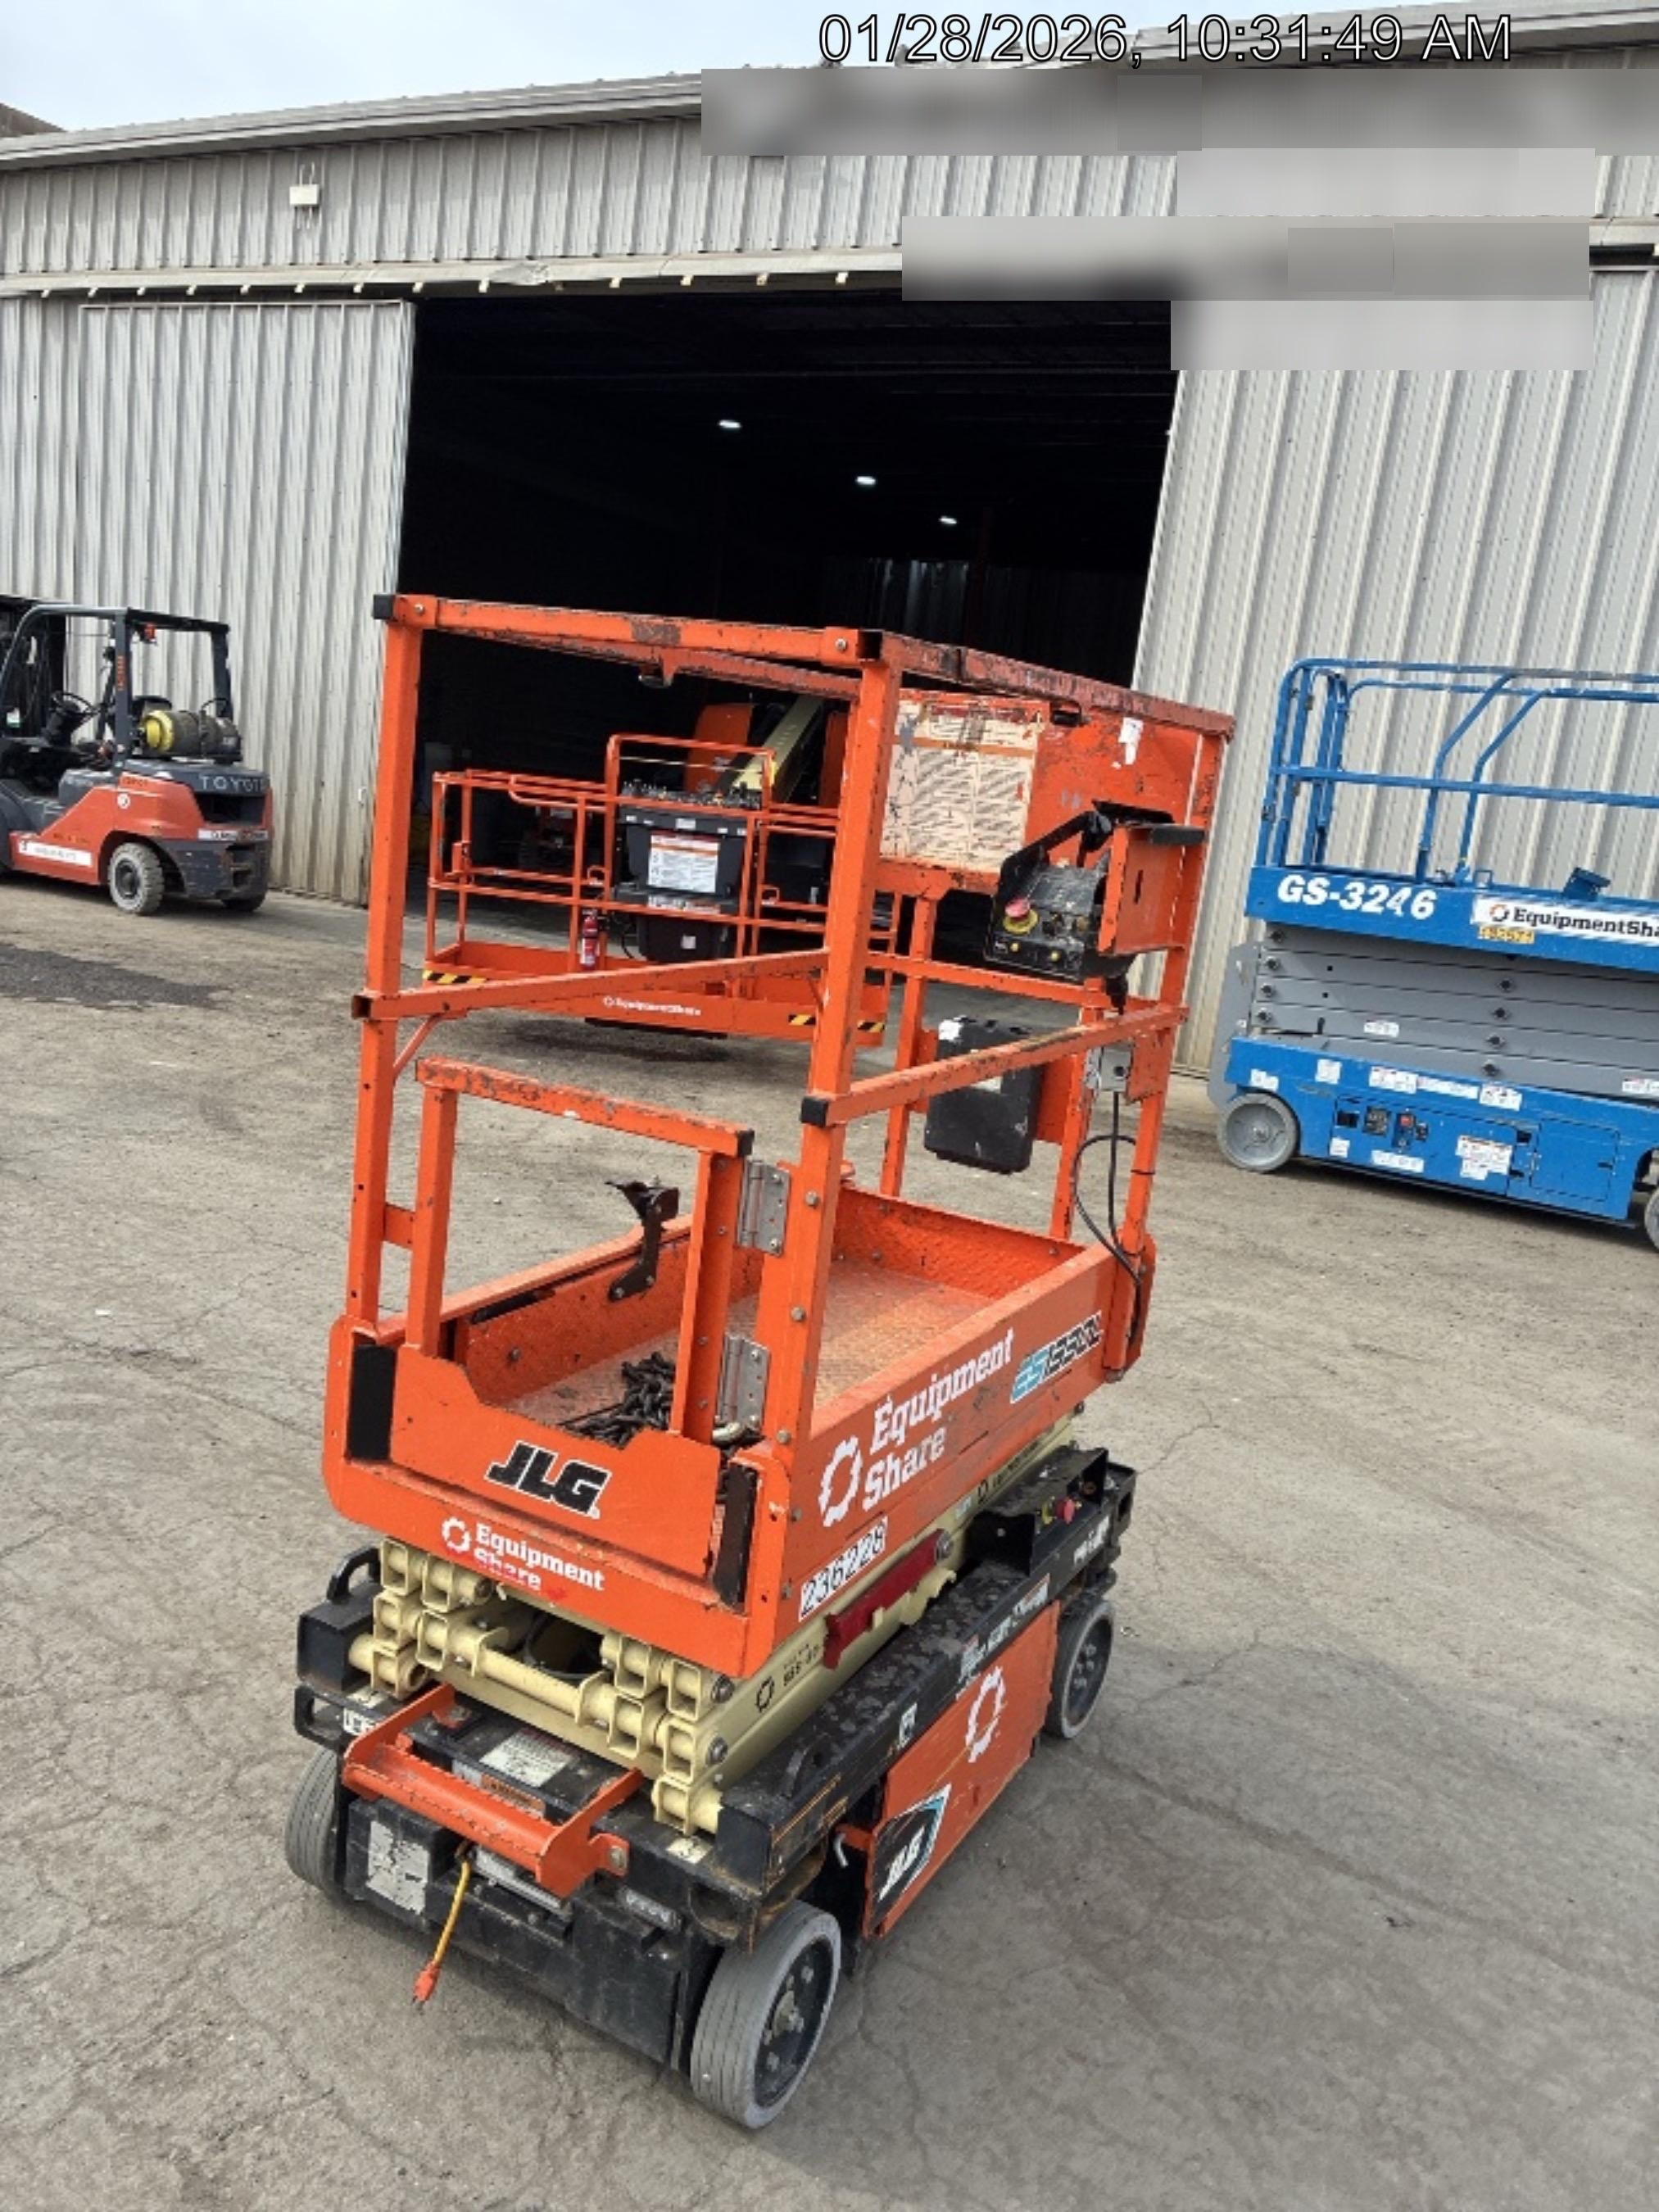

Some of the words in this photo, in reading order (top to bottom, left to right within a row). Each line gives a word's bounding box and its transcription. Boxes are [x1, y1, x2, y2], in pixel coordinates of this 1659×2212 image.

[1277, 874, 1438, 920] GS-3246
[869, 1328, 1015, 1456] Equipment
[483, 1439, 613, 1516] JLG
[862, 1426, 946, 1512] Share
[474, 1547, 542, 1591] Share
[475, 1523, 605, 1591] Equipment
[800, 1521, 885, 1617] 236228
